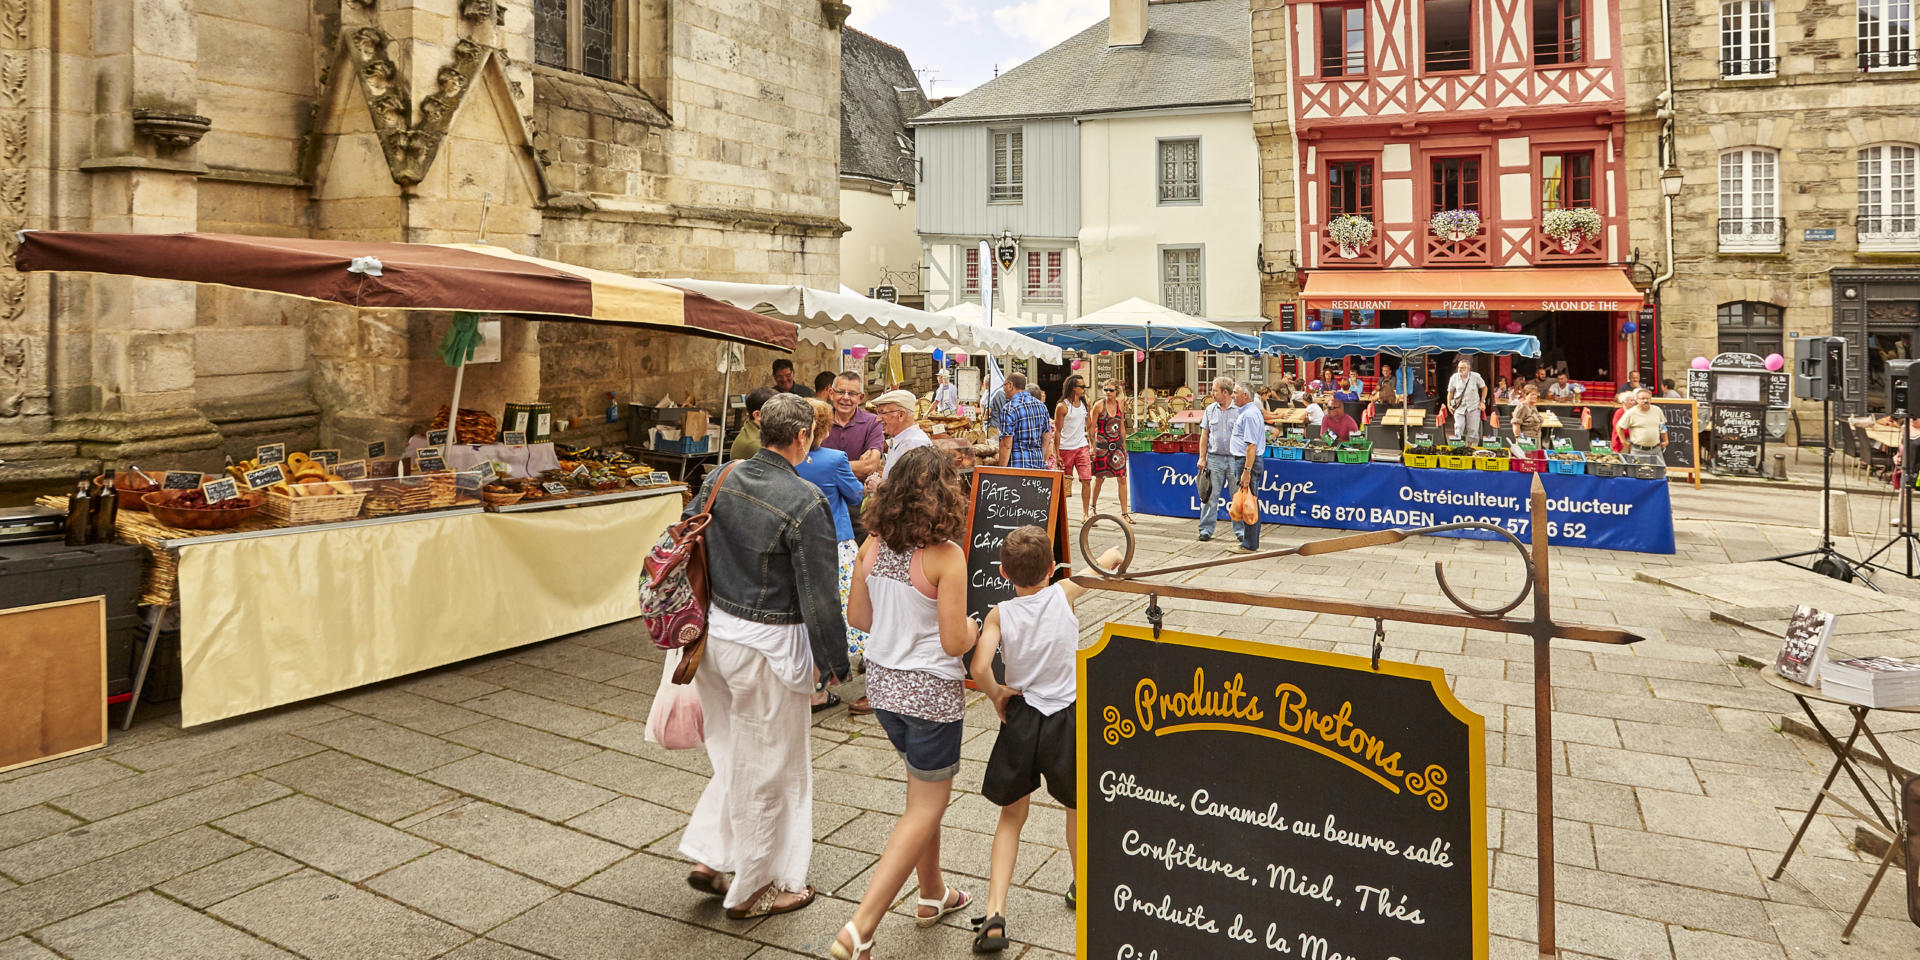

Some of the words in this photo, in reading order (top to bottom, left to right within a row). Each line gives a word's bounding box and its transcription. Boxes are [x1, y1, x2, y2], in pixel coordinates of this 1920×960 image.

[1331, 300, 1392, 310] RESTAURANT
[1443, 300, 1486, 310] PIZZERIA
[1541, 301, 1578, 311] SALON
[1580, 301, 1595, 311] DE
[1598, 301, 1618, 311] THE
[1720, 409, 1751, 419] MOULES
[981, 479, 1021, 503] PÂTES
[1399, 486, 1520, 512] Ostréiculteur,
[1525, 496, 1633, 516] poducteur
[1258, 499, 1297, 517] Neuf
[1311, 505, 1332, 520] 56
[1335, 506, 1366, 523] 870
[1370, 507, 1435, 528] BADEN
[1507, 518, 1530, 535] 57
[1546, 521, 1558, 538] 6
[1562, 522, 1587, 539] 52
[1134, 666, 1264, 732] Produits
[1275, 682, 1405, 777] Bretons
[1100, 770, 1187, 812] Gâteaux,
[1190, 788, 1289, 832] Caramels
[1292, 819, 1321, 839] au
[1323, 814, 1400, 857] beurre
[1402, 836, 1455, 868] salé
[1121, 829, 1259, 887] Confitures,
[1266, 863, 1343, 908] Miel,
[1354, 884, 1426, 925] Thés
[1113, 884, 1220, 935] Produits
[1227, 914, 1258, 944] de
[1265, 922, 1291, 954] la
